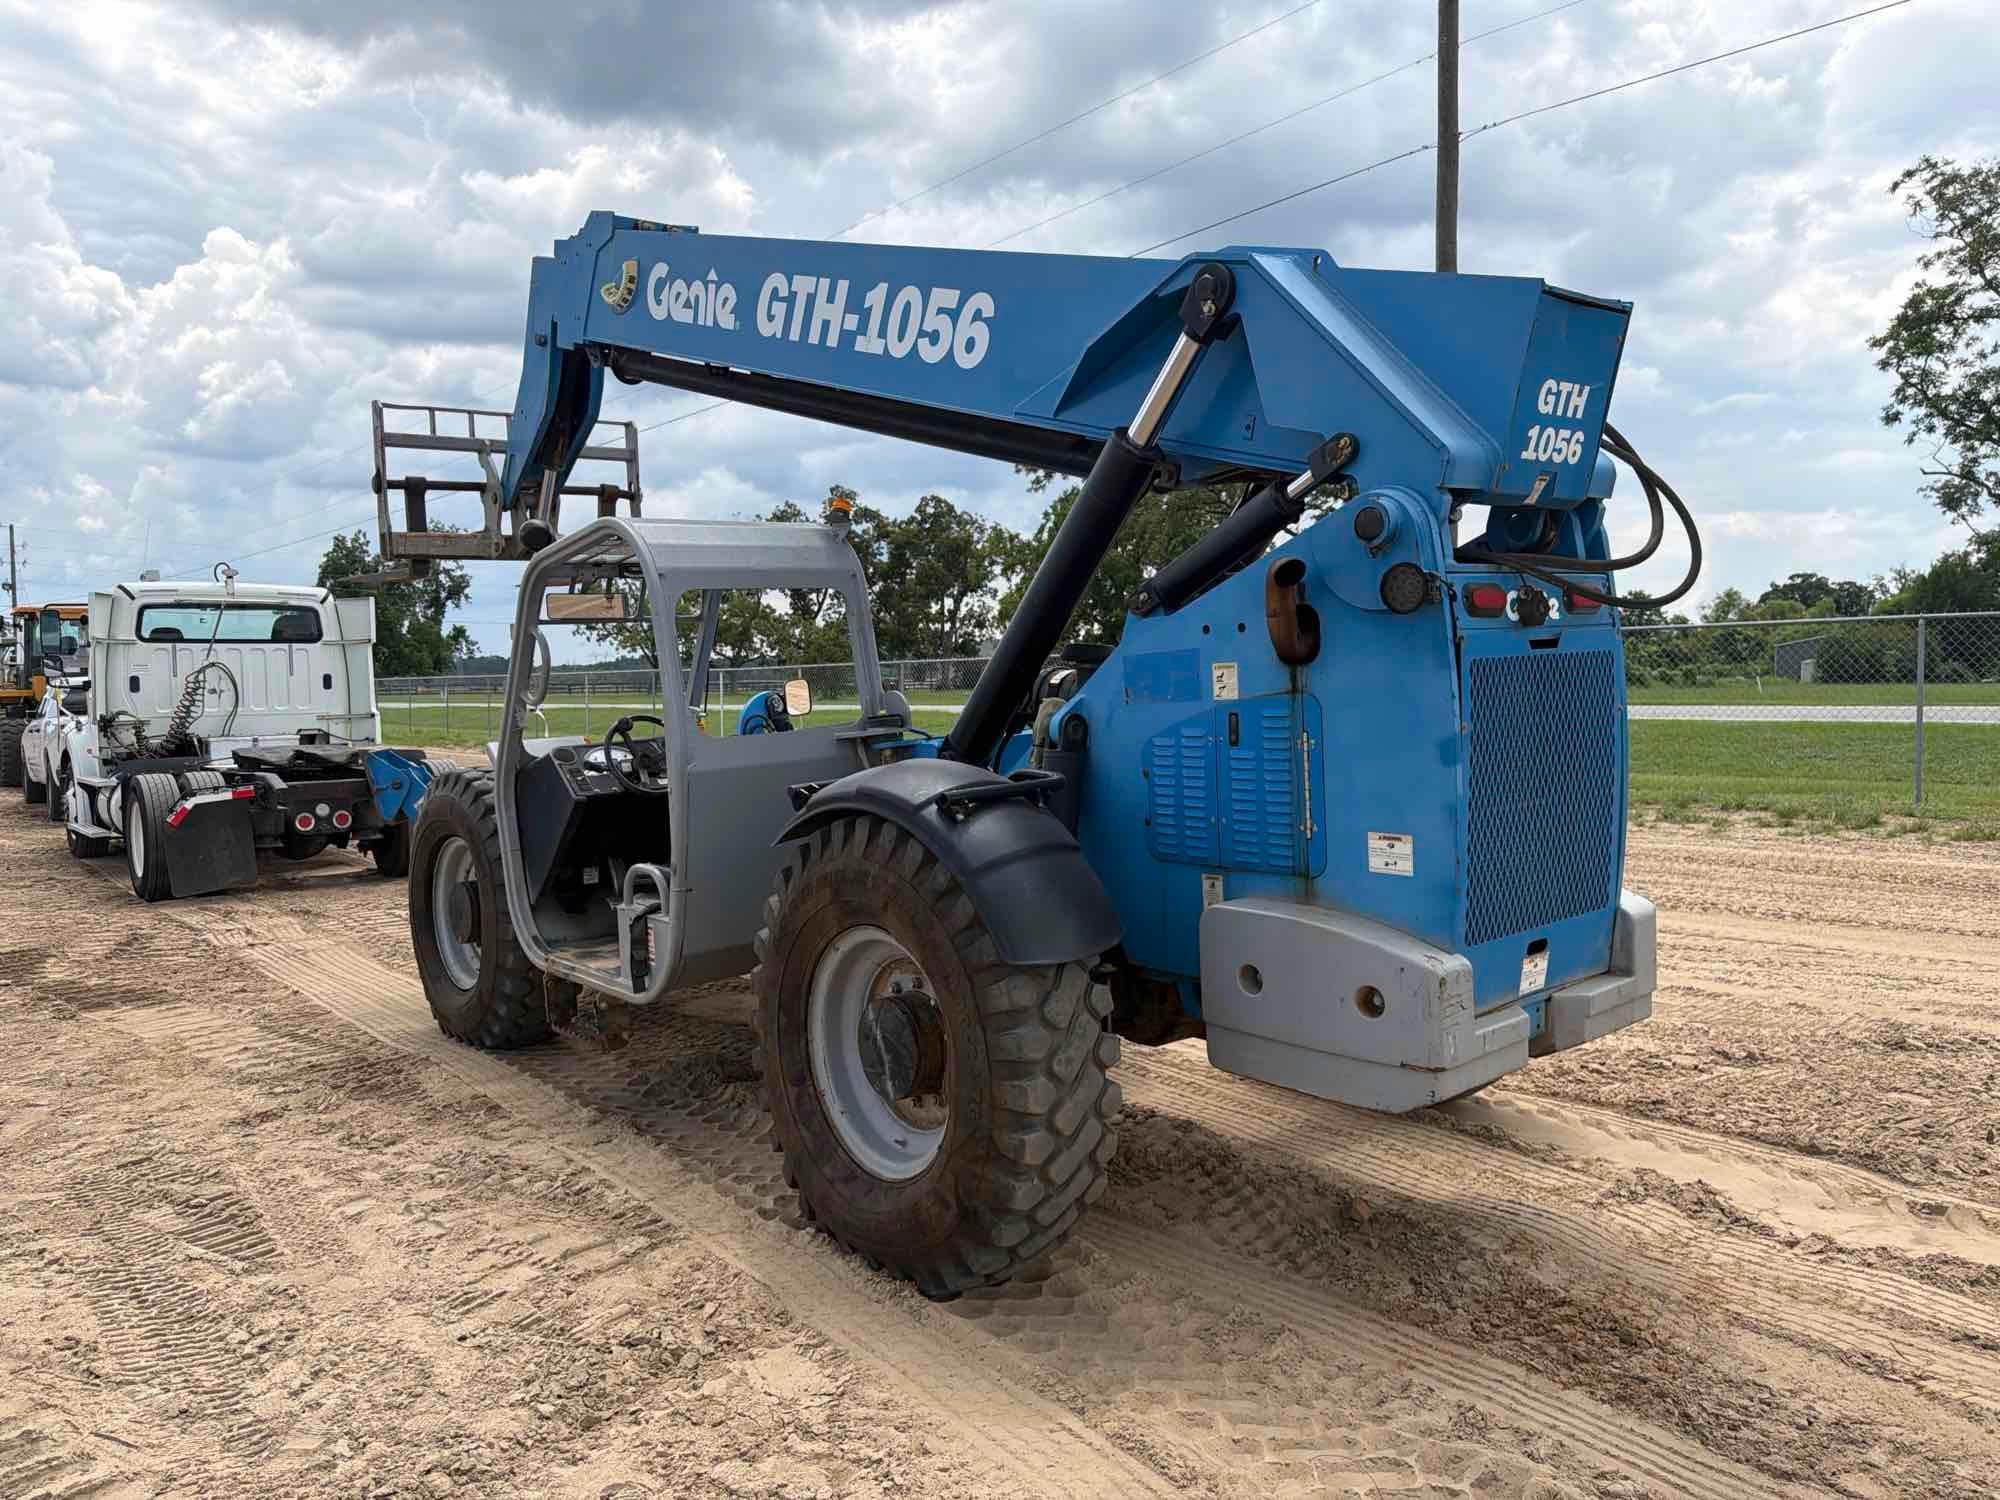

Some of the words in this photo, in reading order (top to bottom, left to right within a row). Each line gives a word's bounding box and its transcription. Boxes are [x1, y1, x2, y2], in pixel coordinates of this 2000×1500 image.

[647, 261, 737, 331] Genie
[756, 272, 995, 370] GTH-1056
[1537, 378, 1590, 419] GTH
[1520, 425, 1585, 465] 1056
